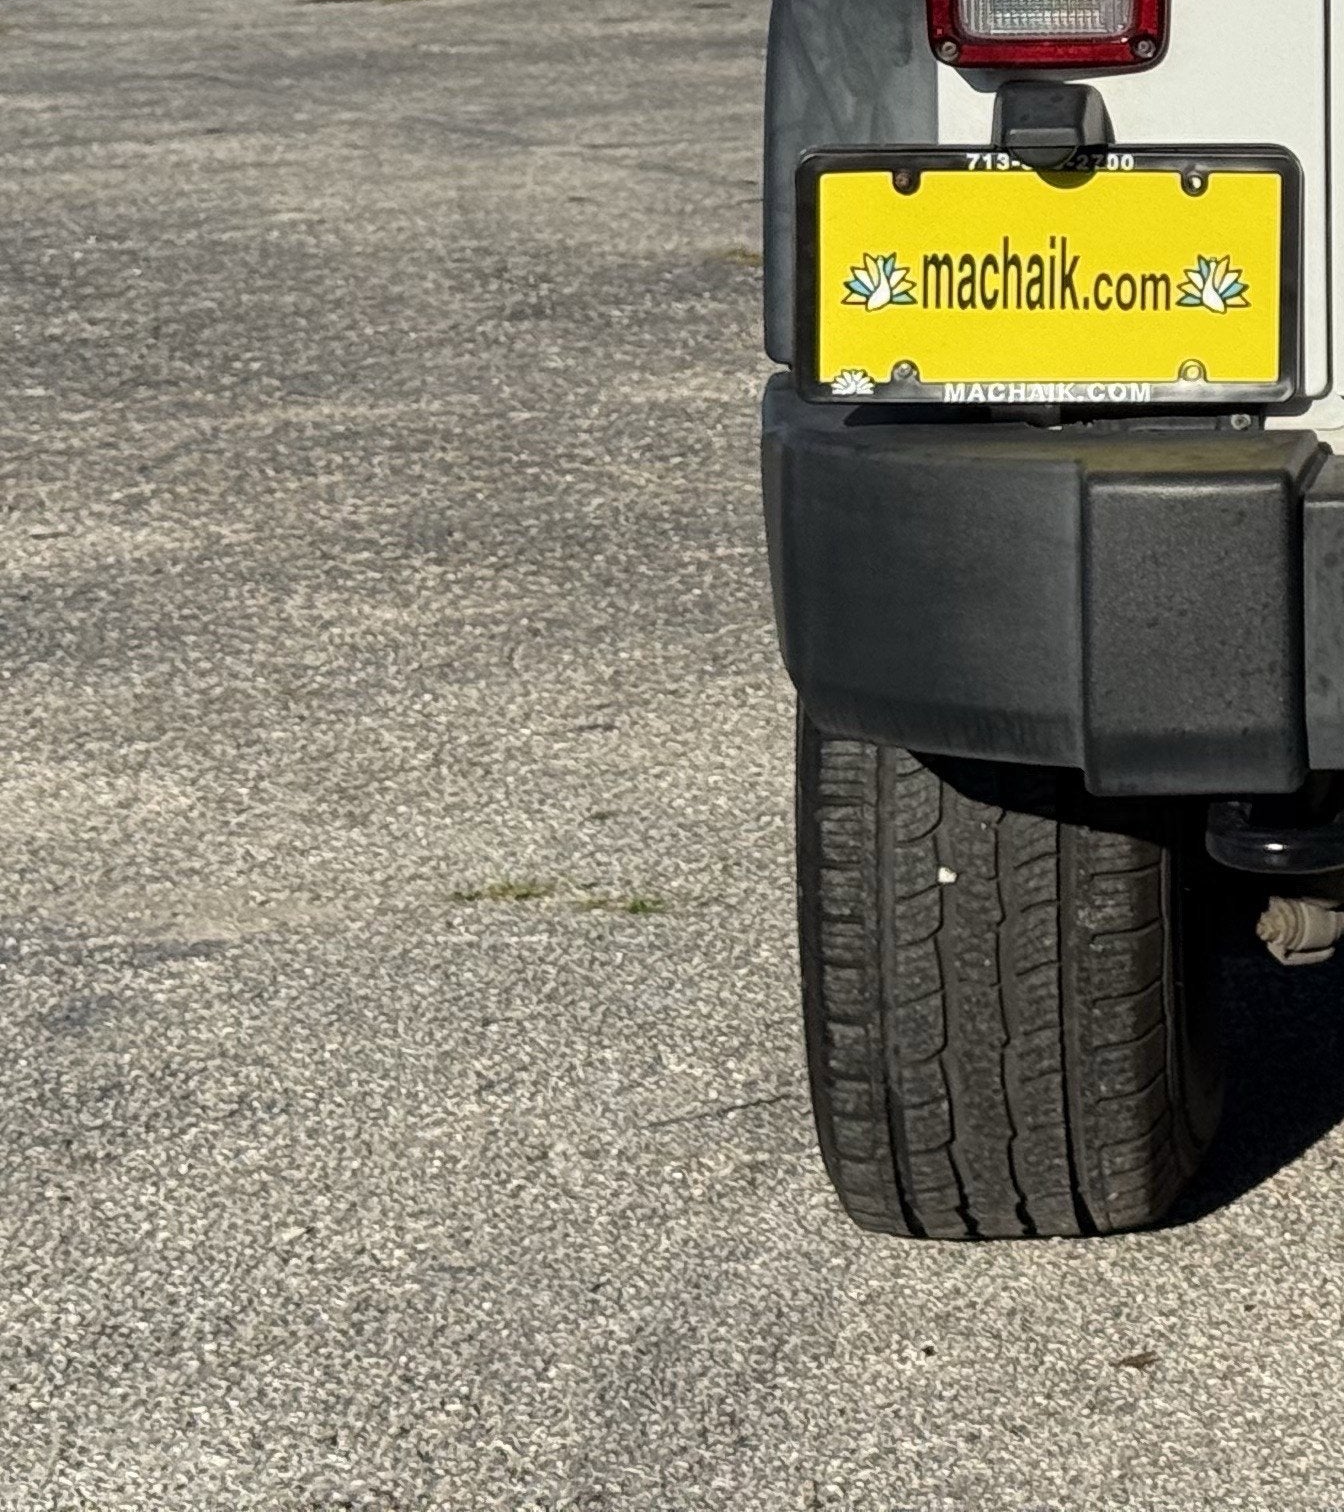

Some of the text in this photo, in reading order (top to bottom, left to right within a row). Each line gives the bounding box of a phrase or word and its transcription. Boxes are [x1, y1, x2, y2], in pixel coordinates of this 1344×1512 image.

[966, 152, 1135, 171] 713--2700
[922, 235, 1171, 312] machaik.com
[943, 382, 1151, 403] MACHAIK.COM
